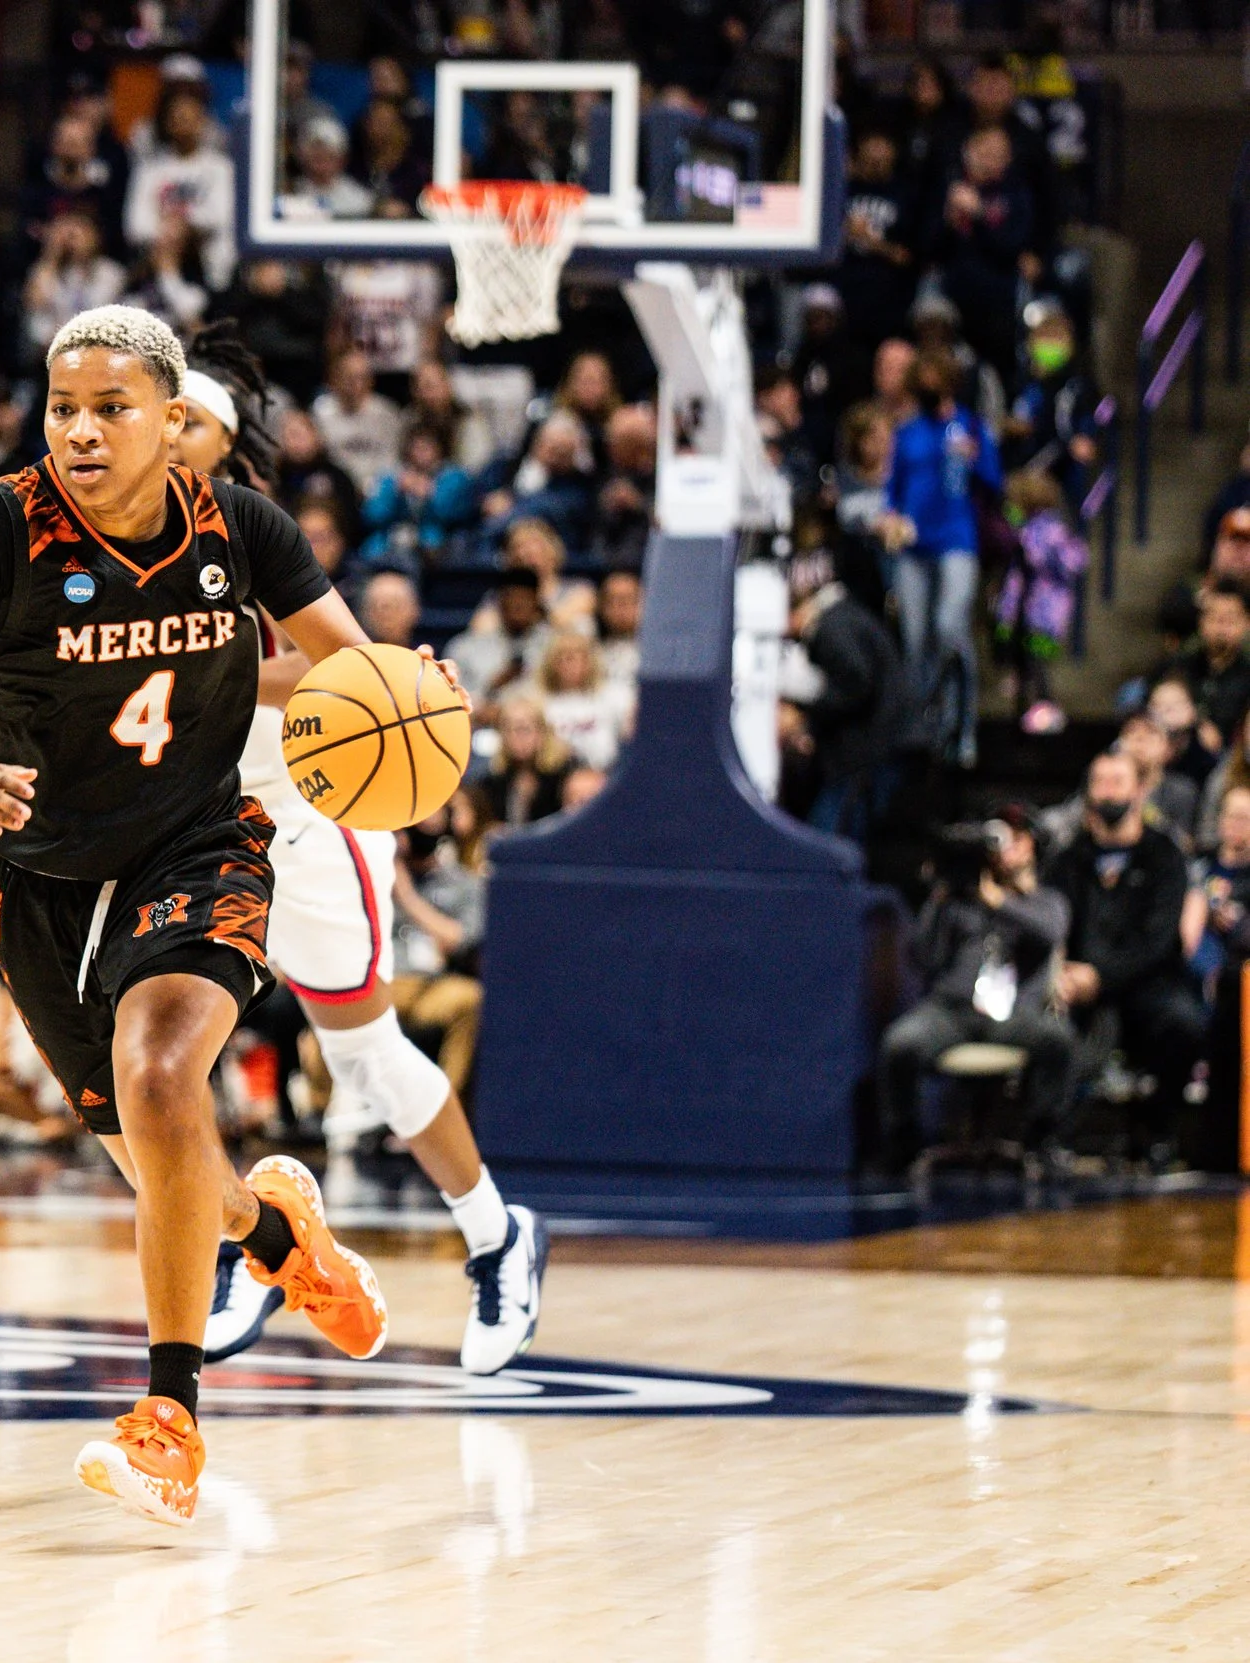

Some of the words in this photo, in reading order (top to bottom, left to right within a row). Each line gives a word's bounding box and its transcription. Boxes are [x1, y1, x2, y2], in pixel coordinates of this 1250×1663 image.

[67, 587, 93, 597] NCAA
[56, 611, 236, 662] MERCER
[109, 669, 176, 767] 4
